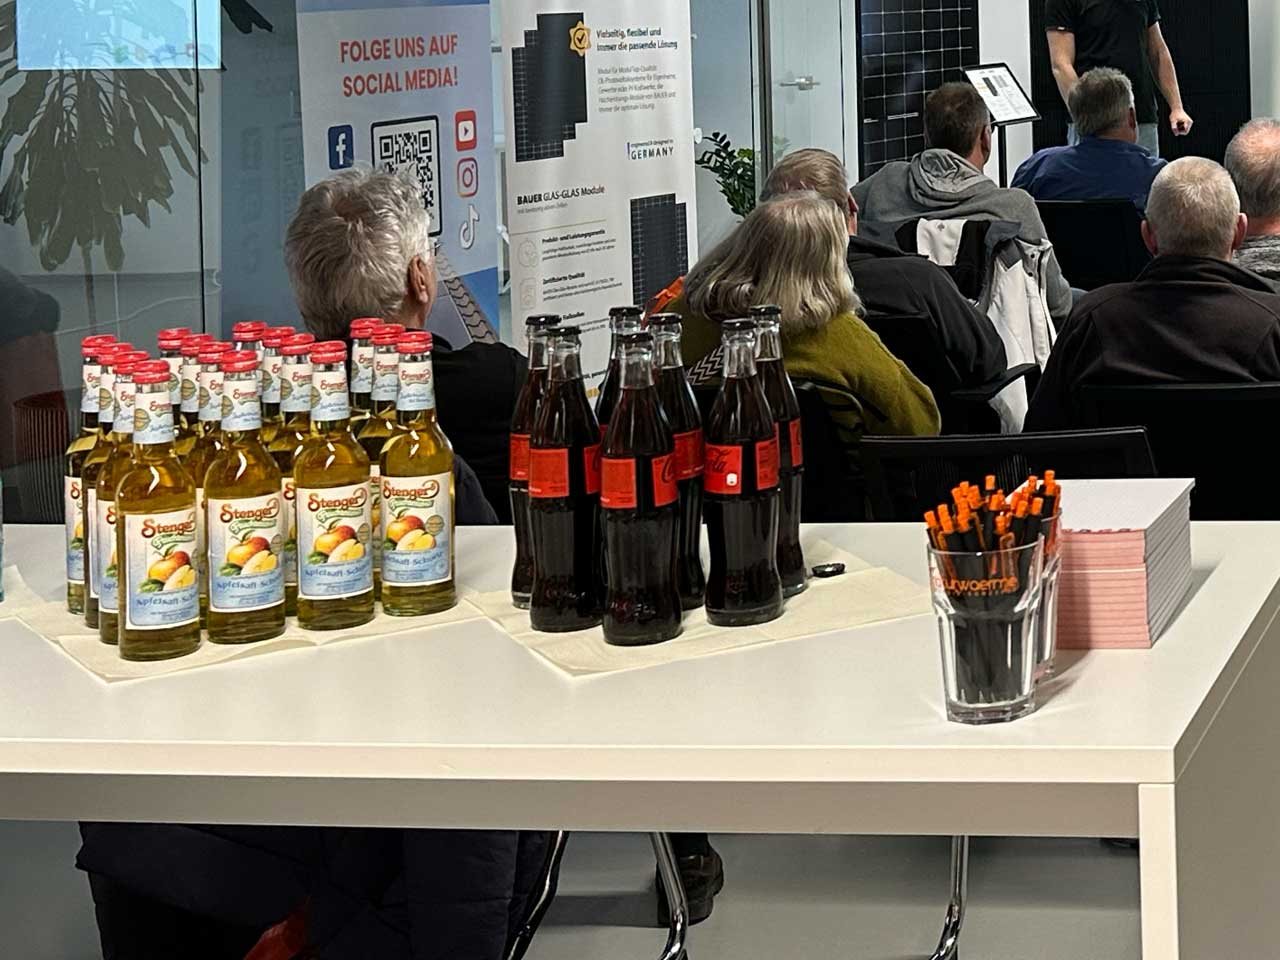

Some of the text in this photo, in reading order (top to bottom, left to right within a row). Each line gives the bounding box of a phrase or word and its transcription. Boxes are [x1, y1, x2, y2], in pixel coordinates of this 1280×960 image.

[340, 34, 459, 63] FOLGE UNS AUF
[343, 67, 458, 96] SOCIAL MEDIA!
[631, 146, 674, 160] GERMANY
[517, 194, 542, 205] BAUER
[308, 487, 368, 512] Stenger
[383, 479, 440, 500] Stenger
[220, 498, 280, 523] Stenger
